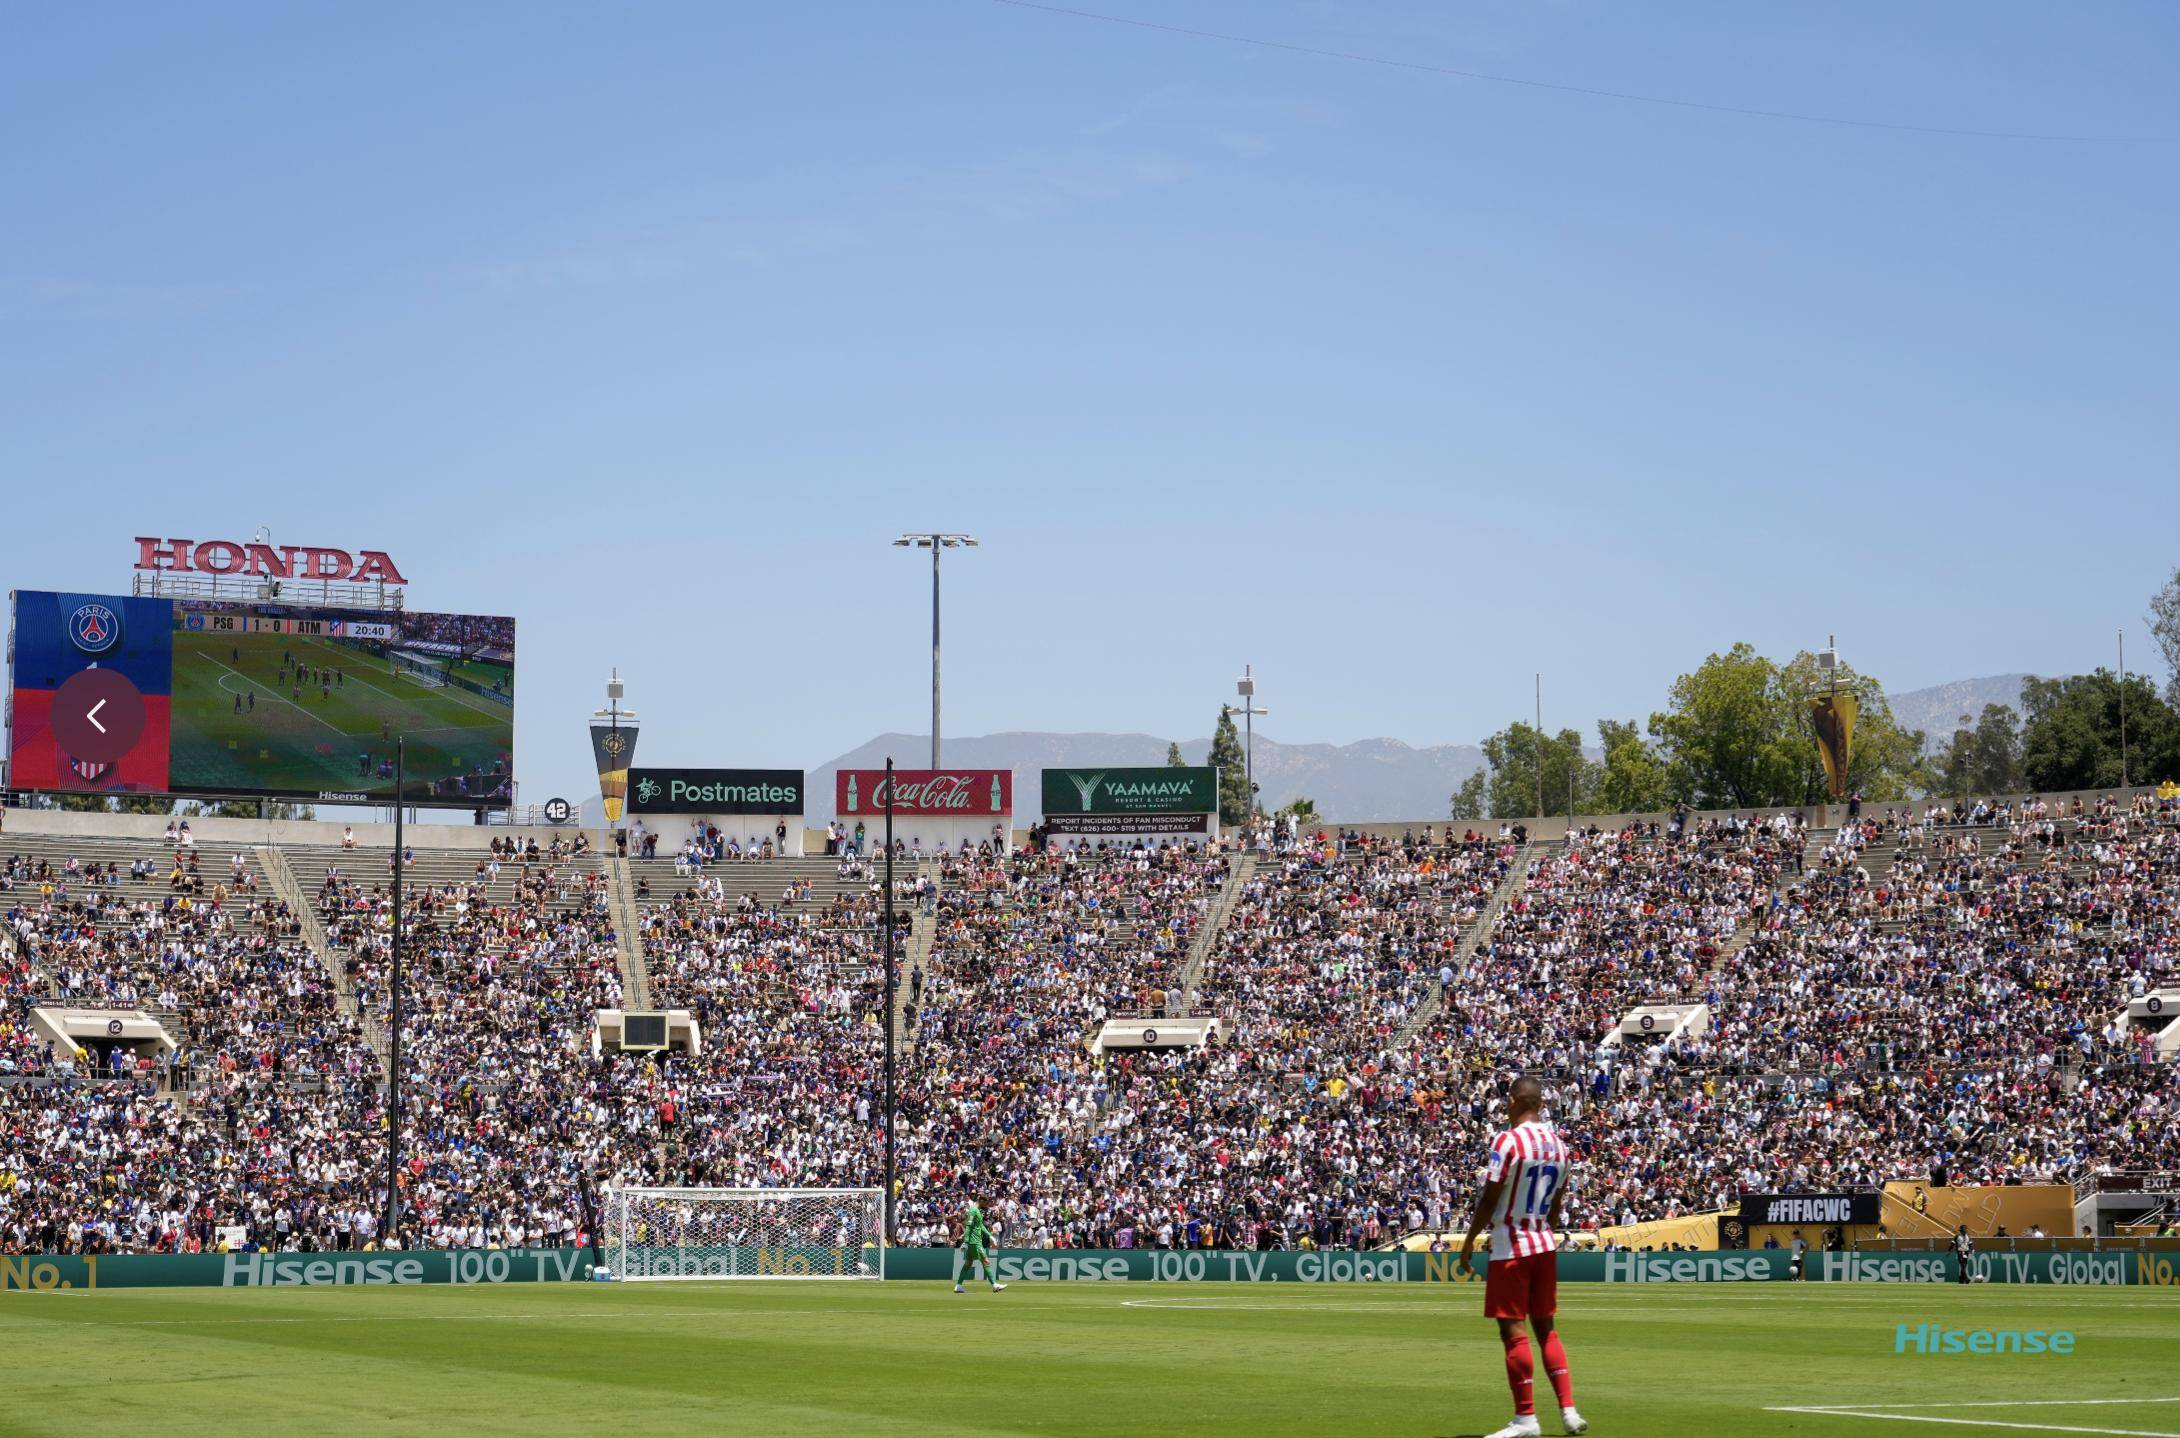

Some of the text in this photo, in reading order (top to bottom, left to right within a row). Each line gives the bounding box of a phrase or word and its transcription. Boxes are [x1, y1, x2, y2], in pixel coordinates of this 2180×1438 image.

[134, 537, 408, 585] HONDA
[77, 607, 110, 619] PARIS
[213, 616, 234, 629] PSG
[254, 619, 260, 631] 1
[273, 620, 281, 632] 0
[297, 621, 321, 635] ATM
[355, 625, 385, 636] 20:40
[319, 791, 368, 801] Hisense
[671, 780, 797, 803] Postmates
[872, 775, 975, 809] Coca-Cola
[546, 802, 567, 819] 42
[1080, 825, 1100, 833] (626)
[2151, 1000, 2159, 1011] 8
[111, 1022, 121, 1032] 12
[1145, 1032, 1155, 1041] 10
[1525, 1165, 1559, 1215] 12
[2142, 1177, 2173, 1189] EXIT
[1767, 1199, 1850, 1223] #FIFACWC
[0, 1256, 97, 1290] No. 1
[222, 1253, 424, 1287] Hisense
[445, 1250, 523, 1284] 100"
[952, 1249, 1482, 1283] Hisense 100" TV, Global No.
[1604, 1251, 1771, 1283] Hisense
[1822, 1251, 2180, 1286] Hisense 00" TV, Global No.
